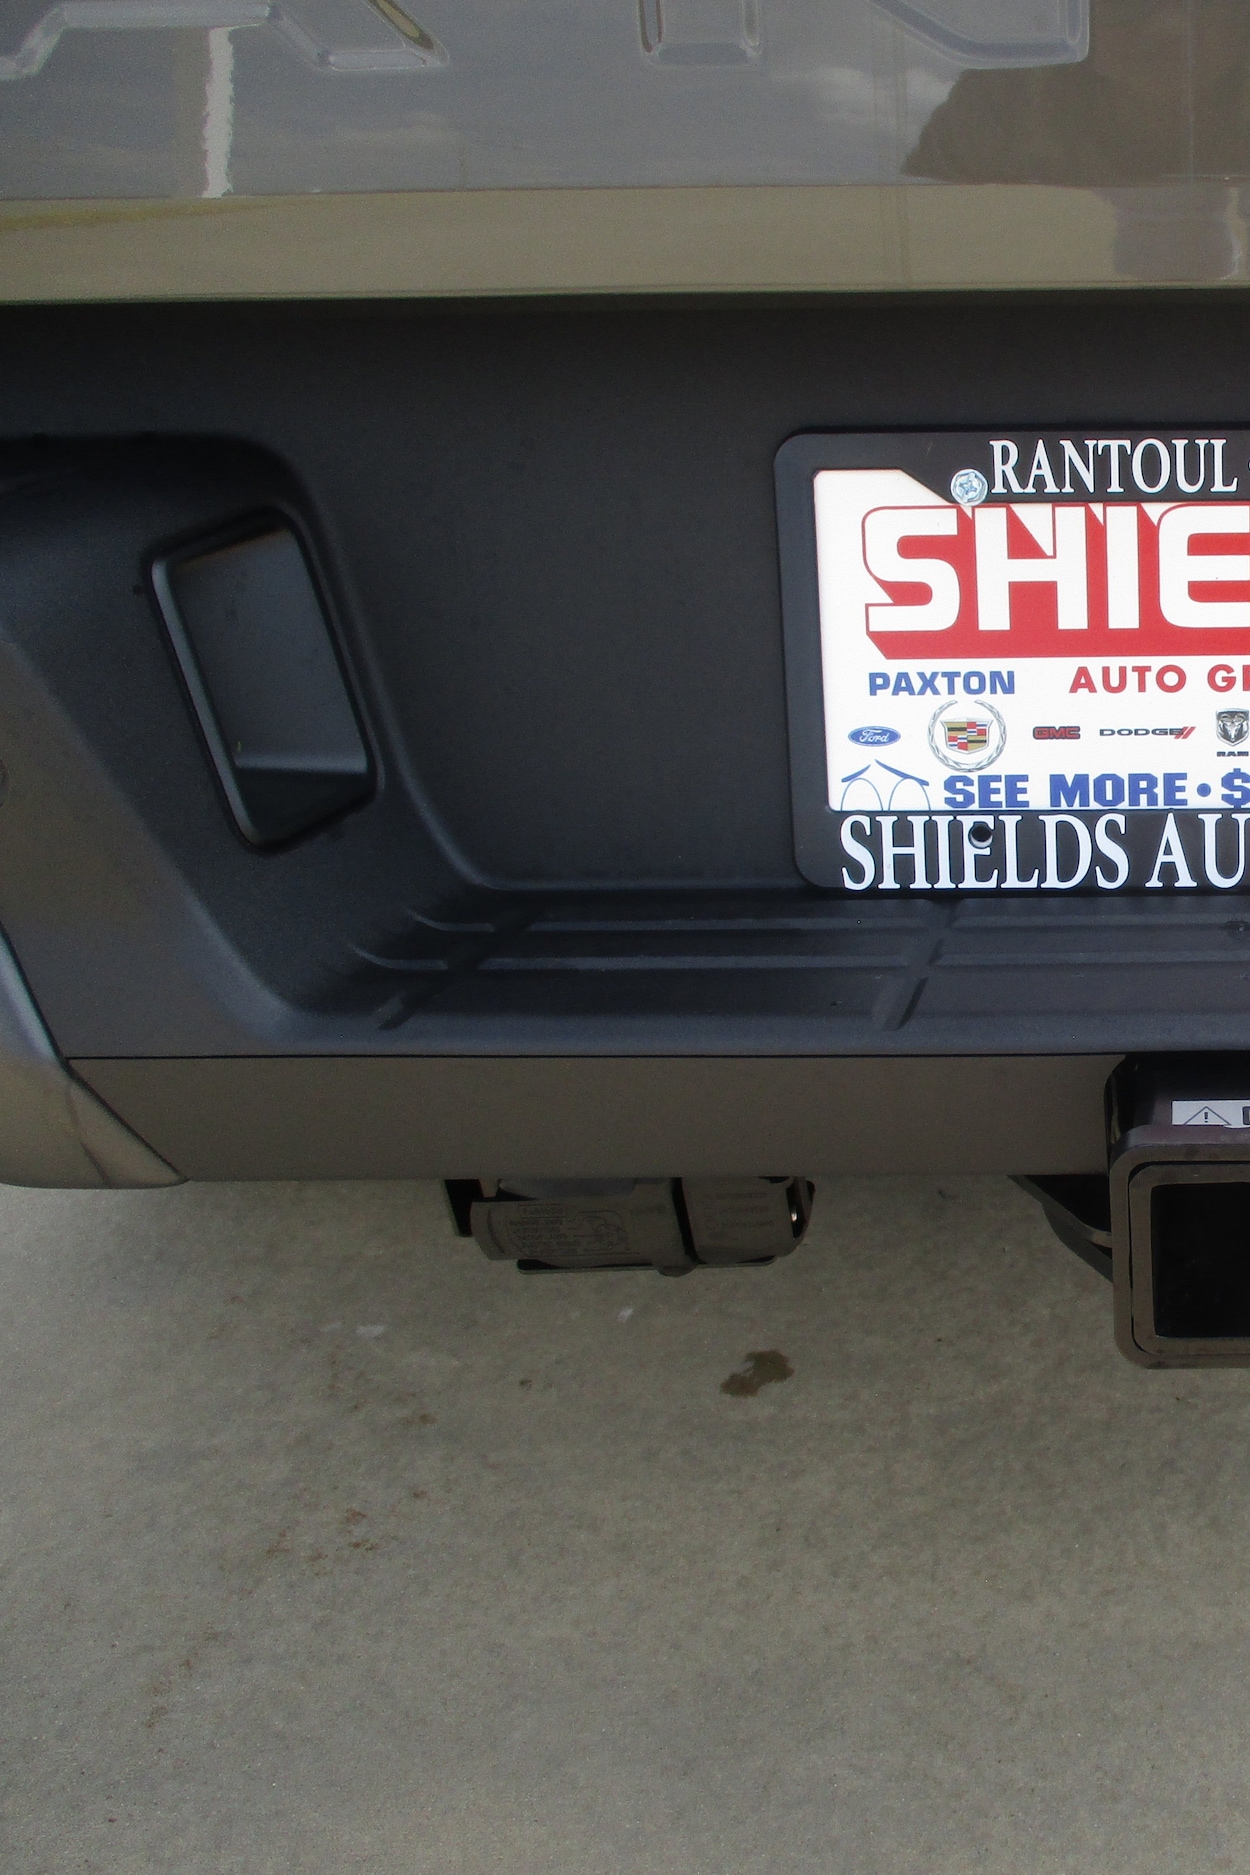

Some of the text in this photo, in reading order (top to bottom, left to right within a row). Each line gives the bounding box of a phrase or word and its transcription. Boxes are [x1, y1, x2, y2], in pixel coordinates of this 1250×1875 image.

[989, 438, 1238, 494] RANTOUL
[868, 670, 1015, 696] PAXTON
[1069, 664, 1187, 693] AUTO
[1033, 726, 1081, 740] GMC
[1099, 728, 1184, 737] DODGE
[944, 774, 1029, 808] SEE
[1050, 772, 1188, 807] MORE
[840, 813, 1130, 890] SHIELDS
